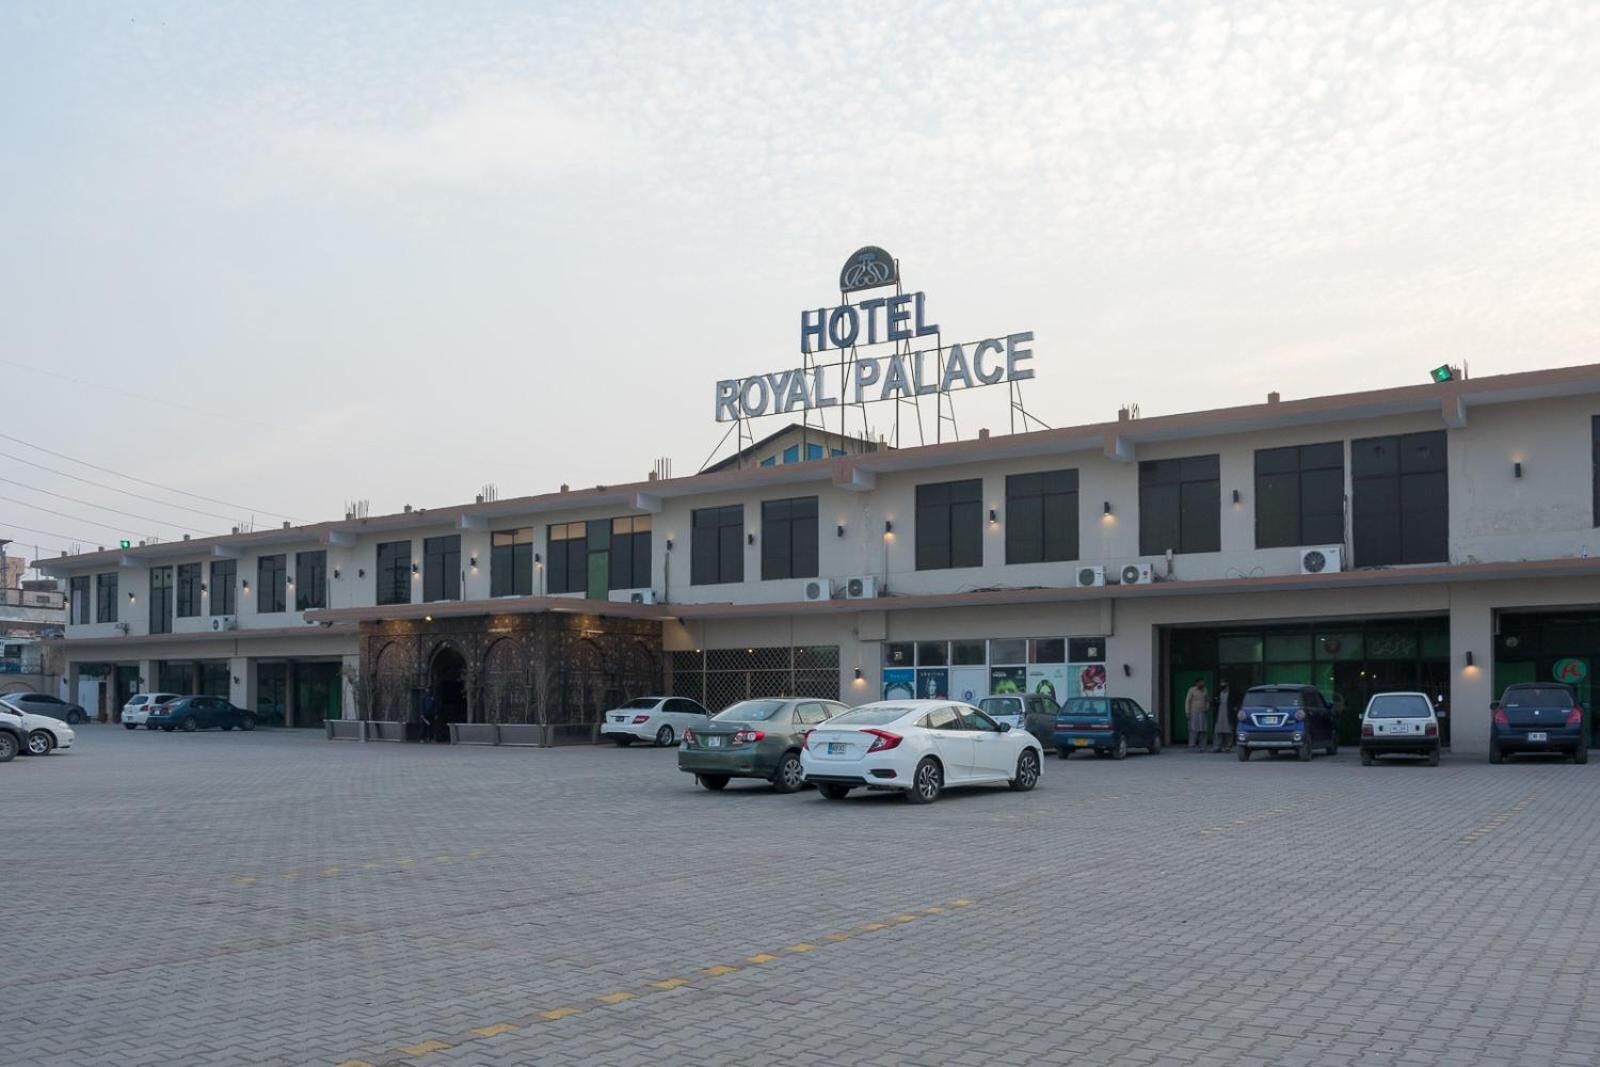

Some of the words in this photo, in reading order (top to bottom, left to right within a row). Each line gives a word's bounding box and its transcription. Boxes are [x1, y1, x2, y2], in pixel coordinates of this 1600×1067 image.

[801, 291, 940, 353] HOTEL
[715, 364, 838, 422] ROYAL
[854, 331, 1036, 403] PALACE
